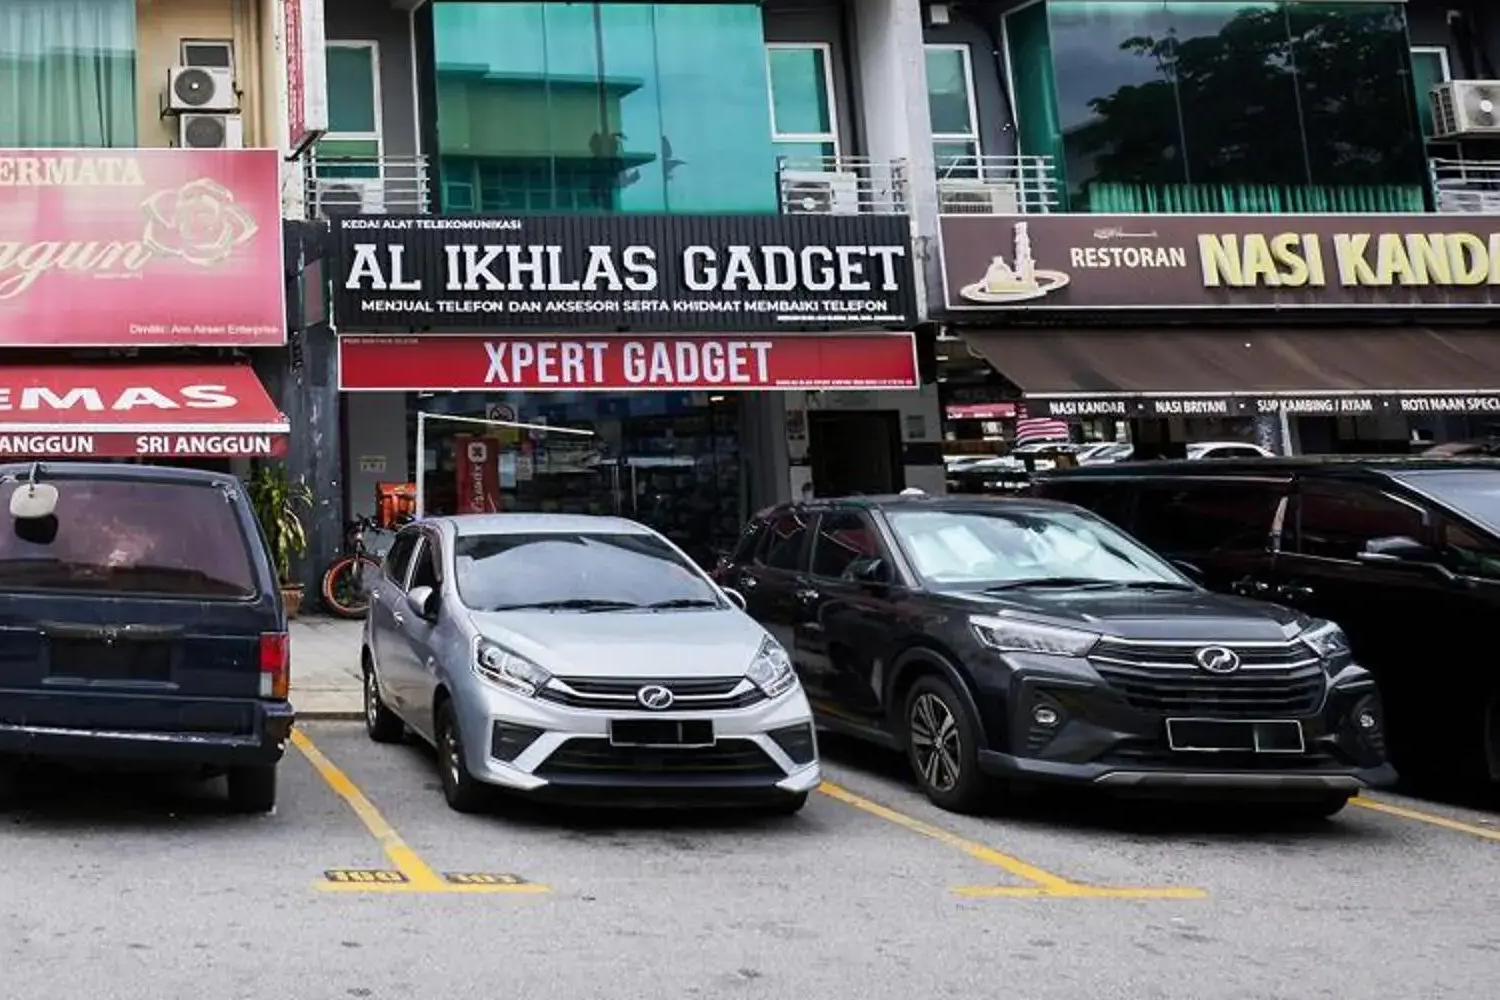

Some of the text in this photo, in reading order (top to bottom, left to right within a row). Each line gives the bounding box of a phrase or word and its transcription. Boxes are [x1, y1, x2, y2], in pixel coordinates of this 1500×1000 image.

[341, 219, 522, 230] KEDAI ALAT TELEKOMUNIKASI
[1070, 247, 1187, 268] RESTORAN
[1197, 232, 1326, 287] NASI
[345, 243, 905, 292] AL IKHLAS GADGET
[361, 300, 888, 313] MENJUAL TELEFON DAN AKSESORI SERTA KHIDMAT MEMBAIKI TELEFON
[483, 341, 773, 383] XPERT GADGET
[1050, 401, 1126, 415] NASI KANDAR
[1155, 400, 1228, 413] NASI BRIYANI
[1257, 401, 1279, 412] SUP
[1280, 400, 1333, 412] KAMBING
[1341, 400, 1373, 411] AYAM
[1401, 399, 1428, 411] ROTI
[1430, 399, 1466, 411] NAAN
[136, 435, 271, 454] SRI ANGGUN
